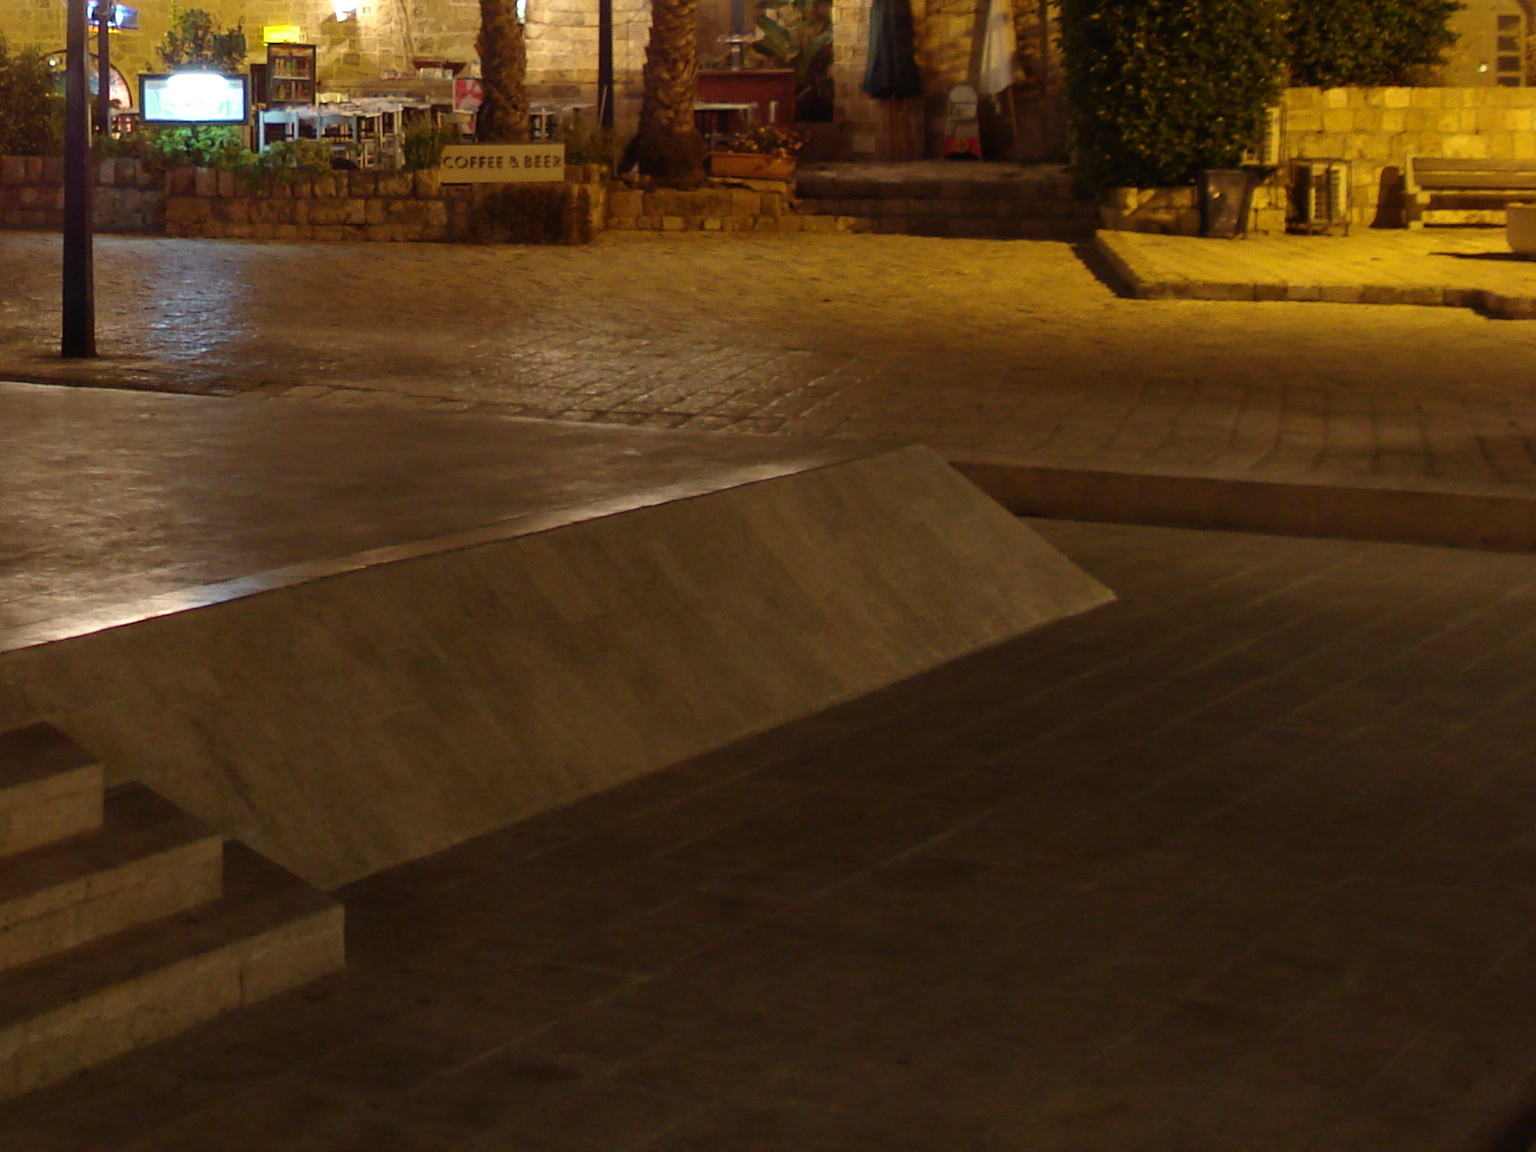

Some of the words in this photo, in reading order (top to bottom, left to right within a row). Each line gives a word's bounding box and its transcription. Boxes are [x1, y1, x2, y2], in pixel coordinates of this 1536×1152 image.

[442, 155, 504, 170] COFFEE
[510, 156, 520, 169] &
[523, 154, 562, 169] BEER
